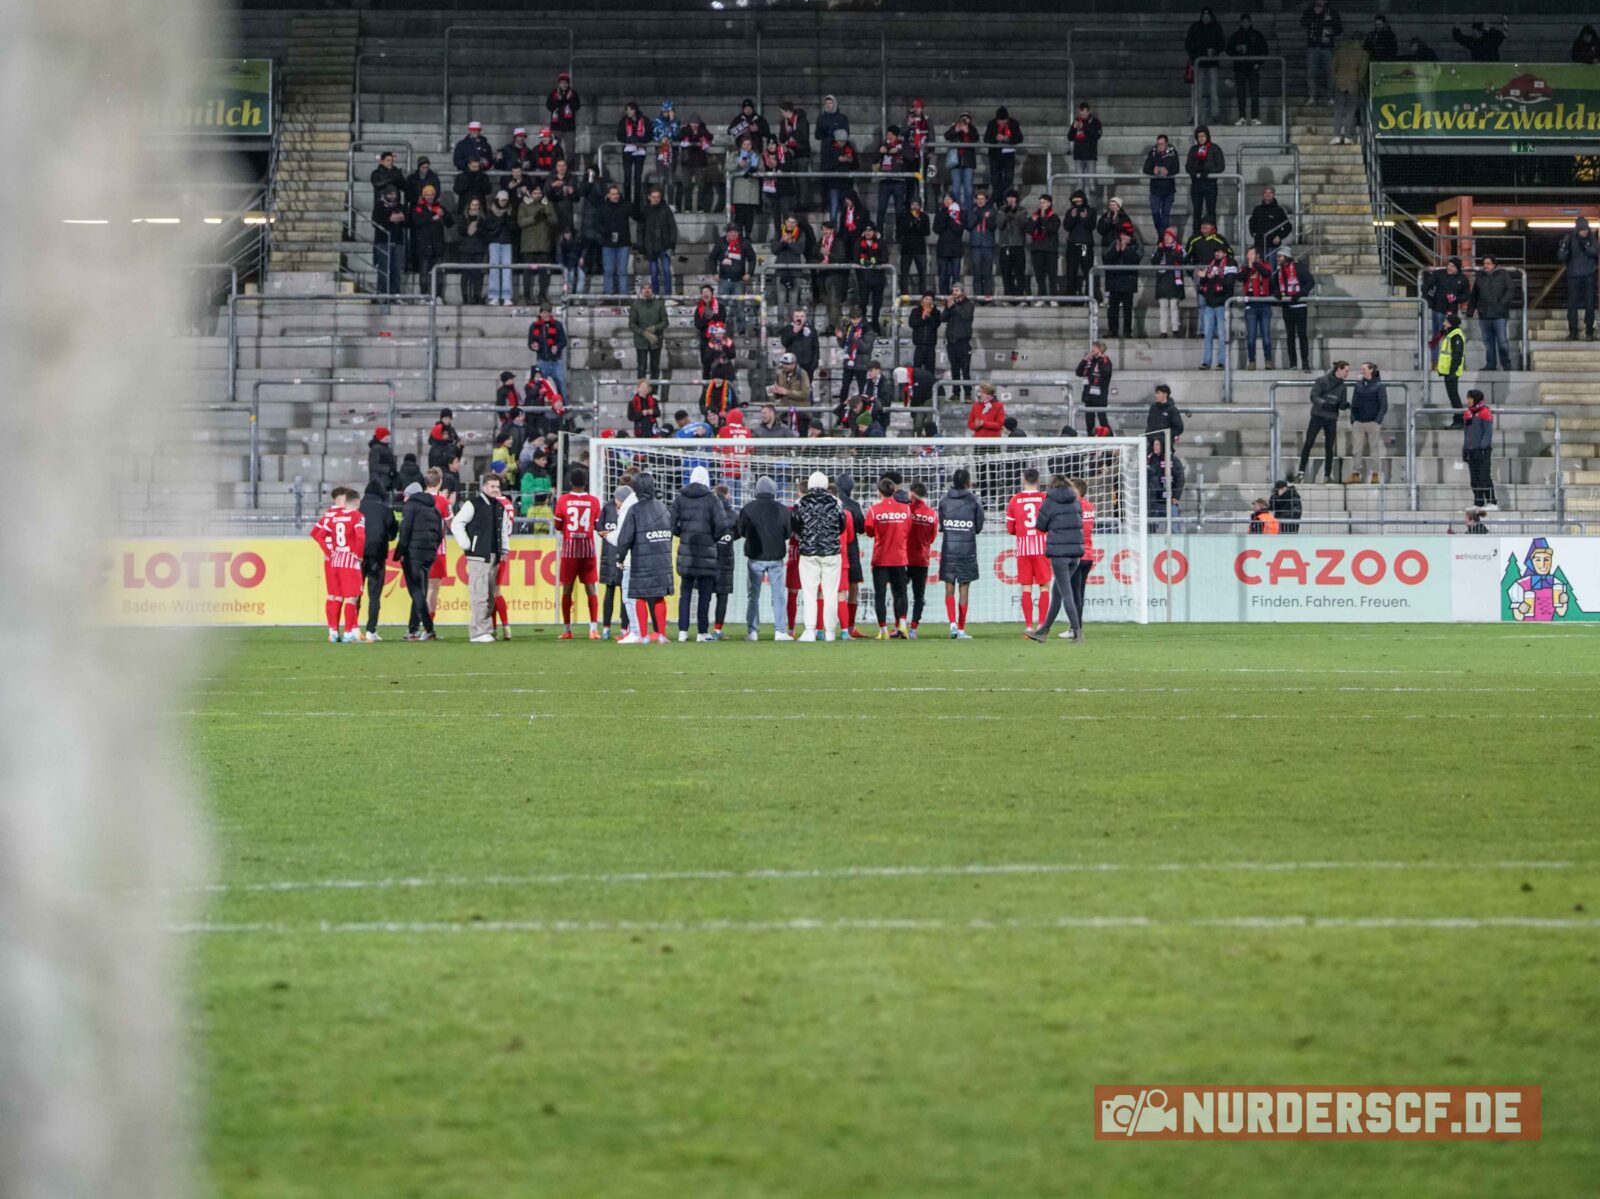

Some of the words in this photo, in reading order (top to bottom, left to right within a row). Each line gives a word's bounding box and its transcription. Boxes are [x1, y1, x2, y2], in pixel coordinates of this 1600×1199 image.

[566, 506, 591, 532] 34
[875, 512, 908, 521] CAZOO
[911, 513, 934, 523] AZOO
[1023, 502, 1037, 528] 3
[943, 519, 974, 528] CAZOO
[335, 522, 346, 547] 8
[646, 530, 672, 540] CAZOO
[123, 551, 266, 588] LOTTO
[1233, 549, 1429, 585] CAZOO
[122, 599, 265, 615] Baden-Württemberg
[1252, 595, 1303, 608] Finden.
[1305, 595, 1357, 608] Fahren.
[1360, 595, 1411, 608] Freuen.
